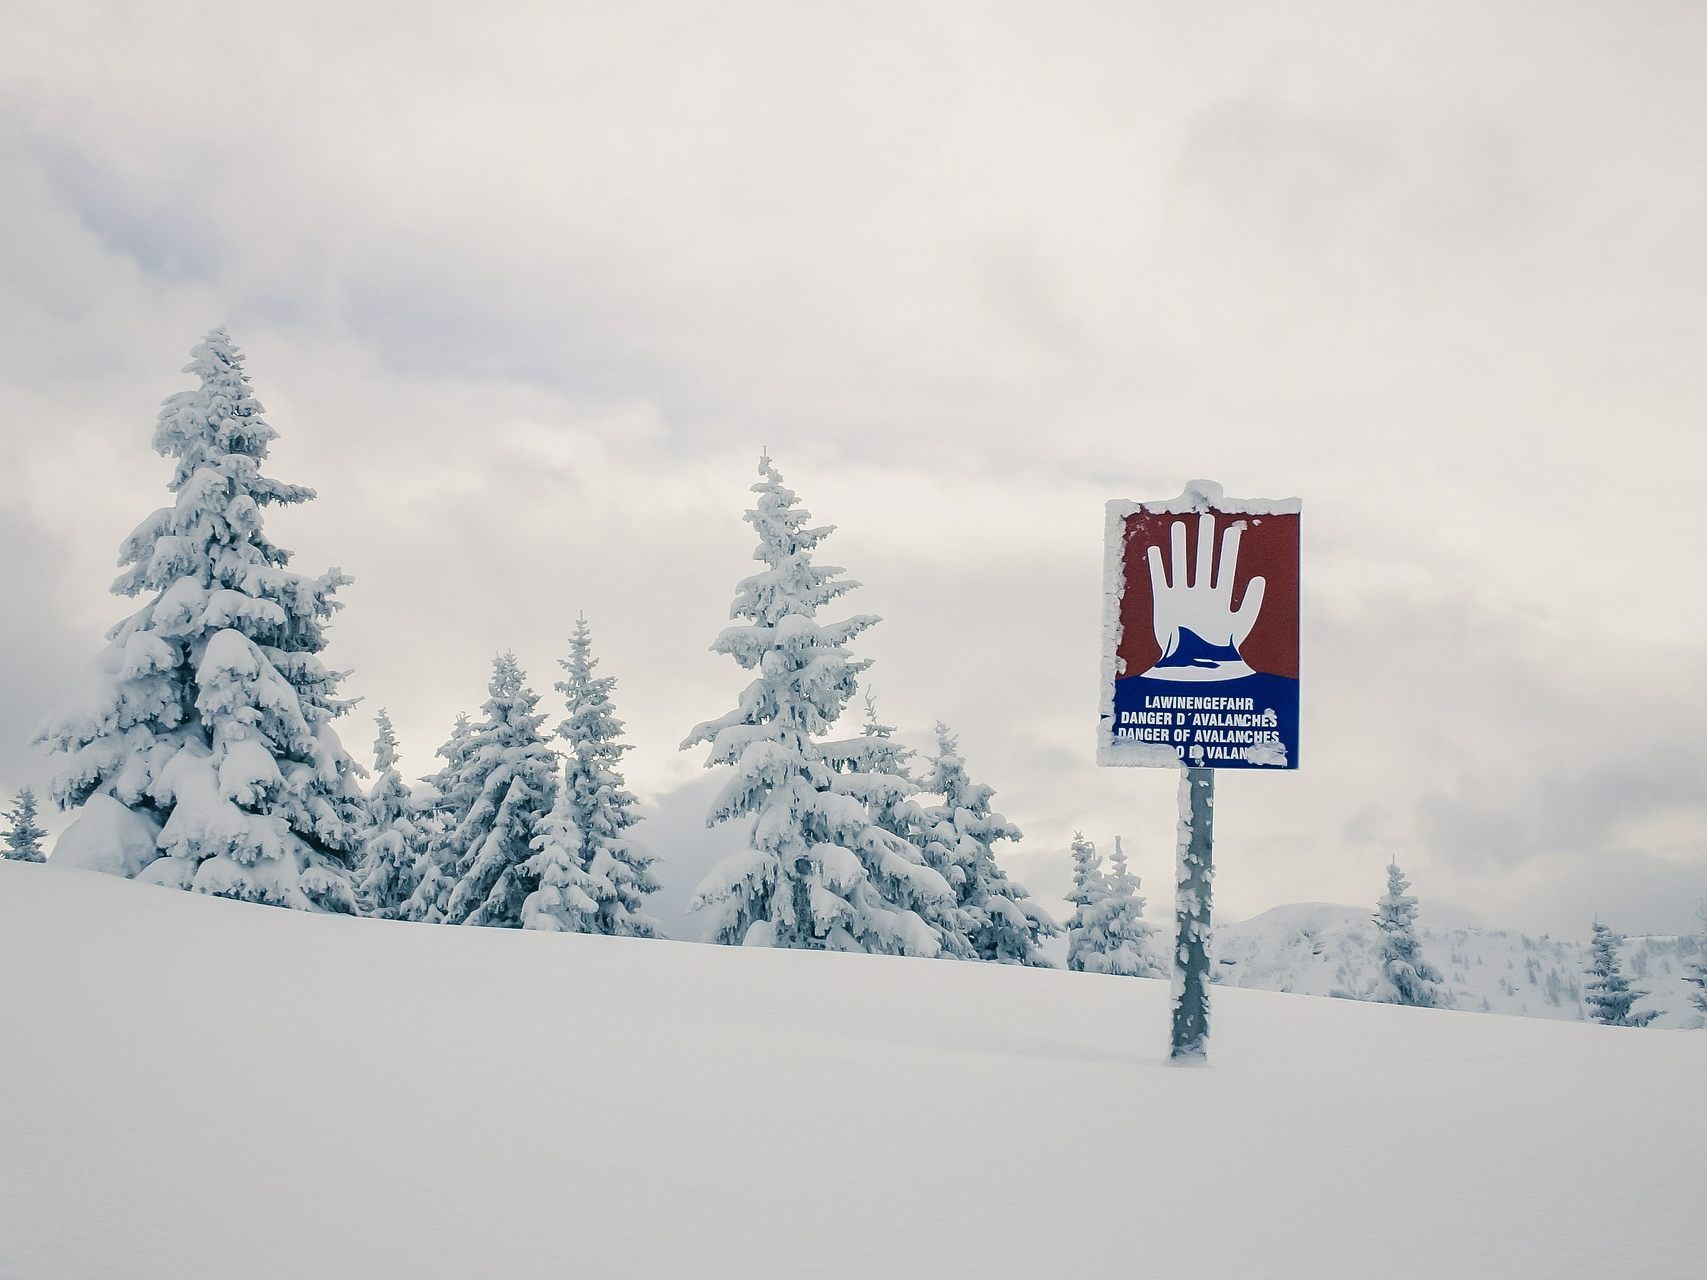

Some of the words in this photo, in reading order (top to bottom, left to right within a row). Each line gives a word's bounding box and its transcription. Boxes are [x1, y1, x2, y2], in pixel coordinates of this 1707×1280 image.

[1145, 695, 1254, 711] LAWINENGEFAHR
[1121, 711, 1173, 726] DANGER
[1118, 727, 1170, 741] DANGER
[1173, 728, 1191, 742] OF
[1193, 729, 1280, 743] AVALANCHES
